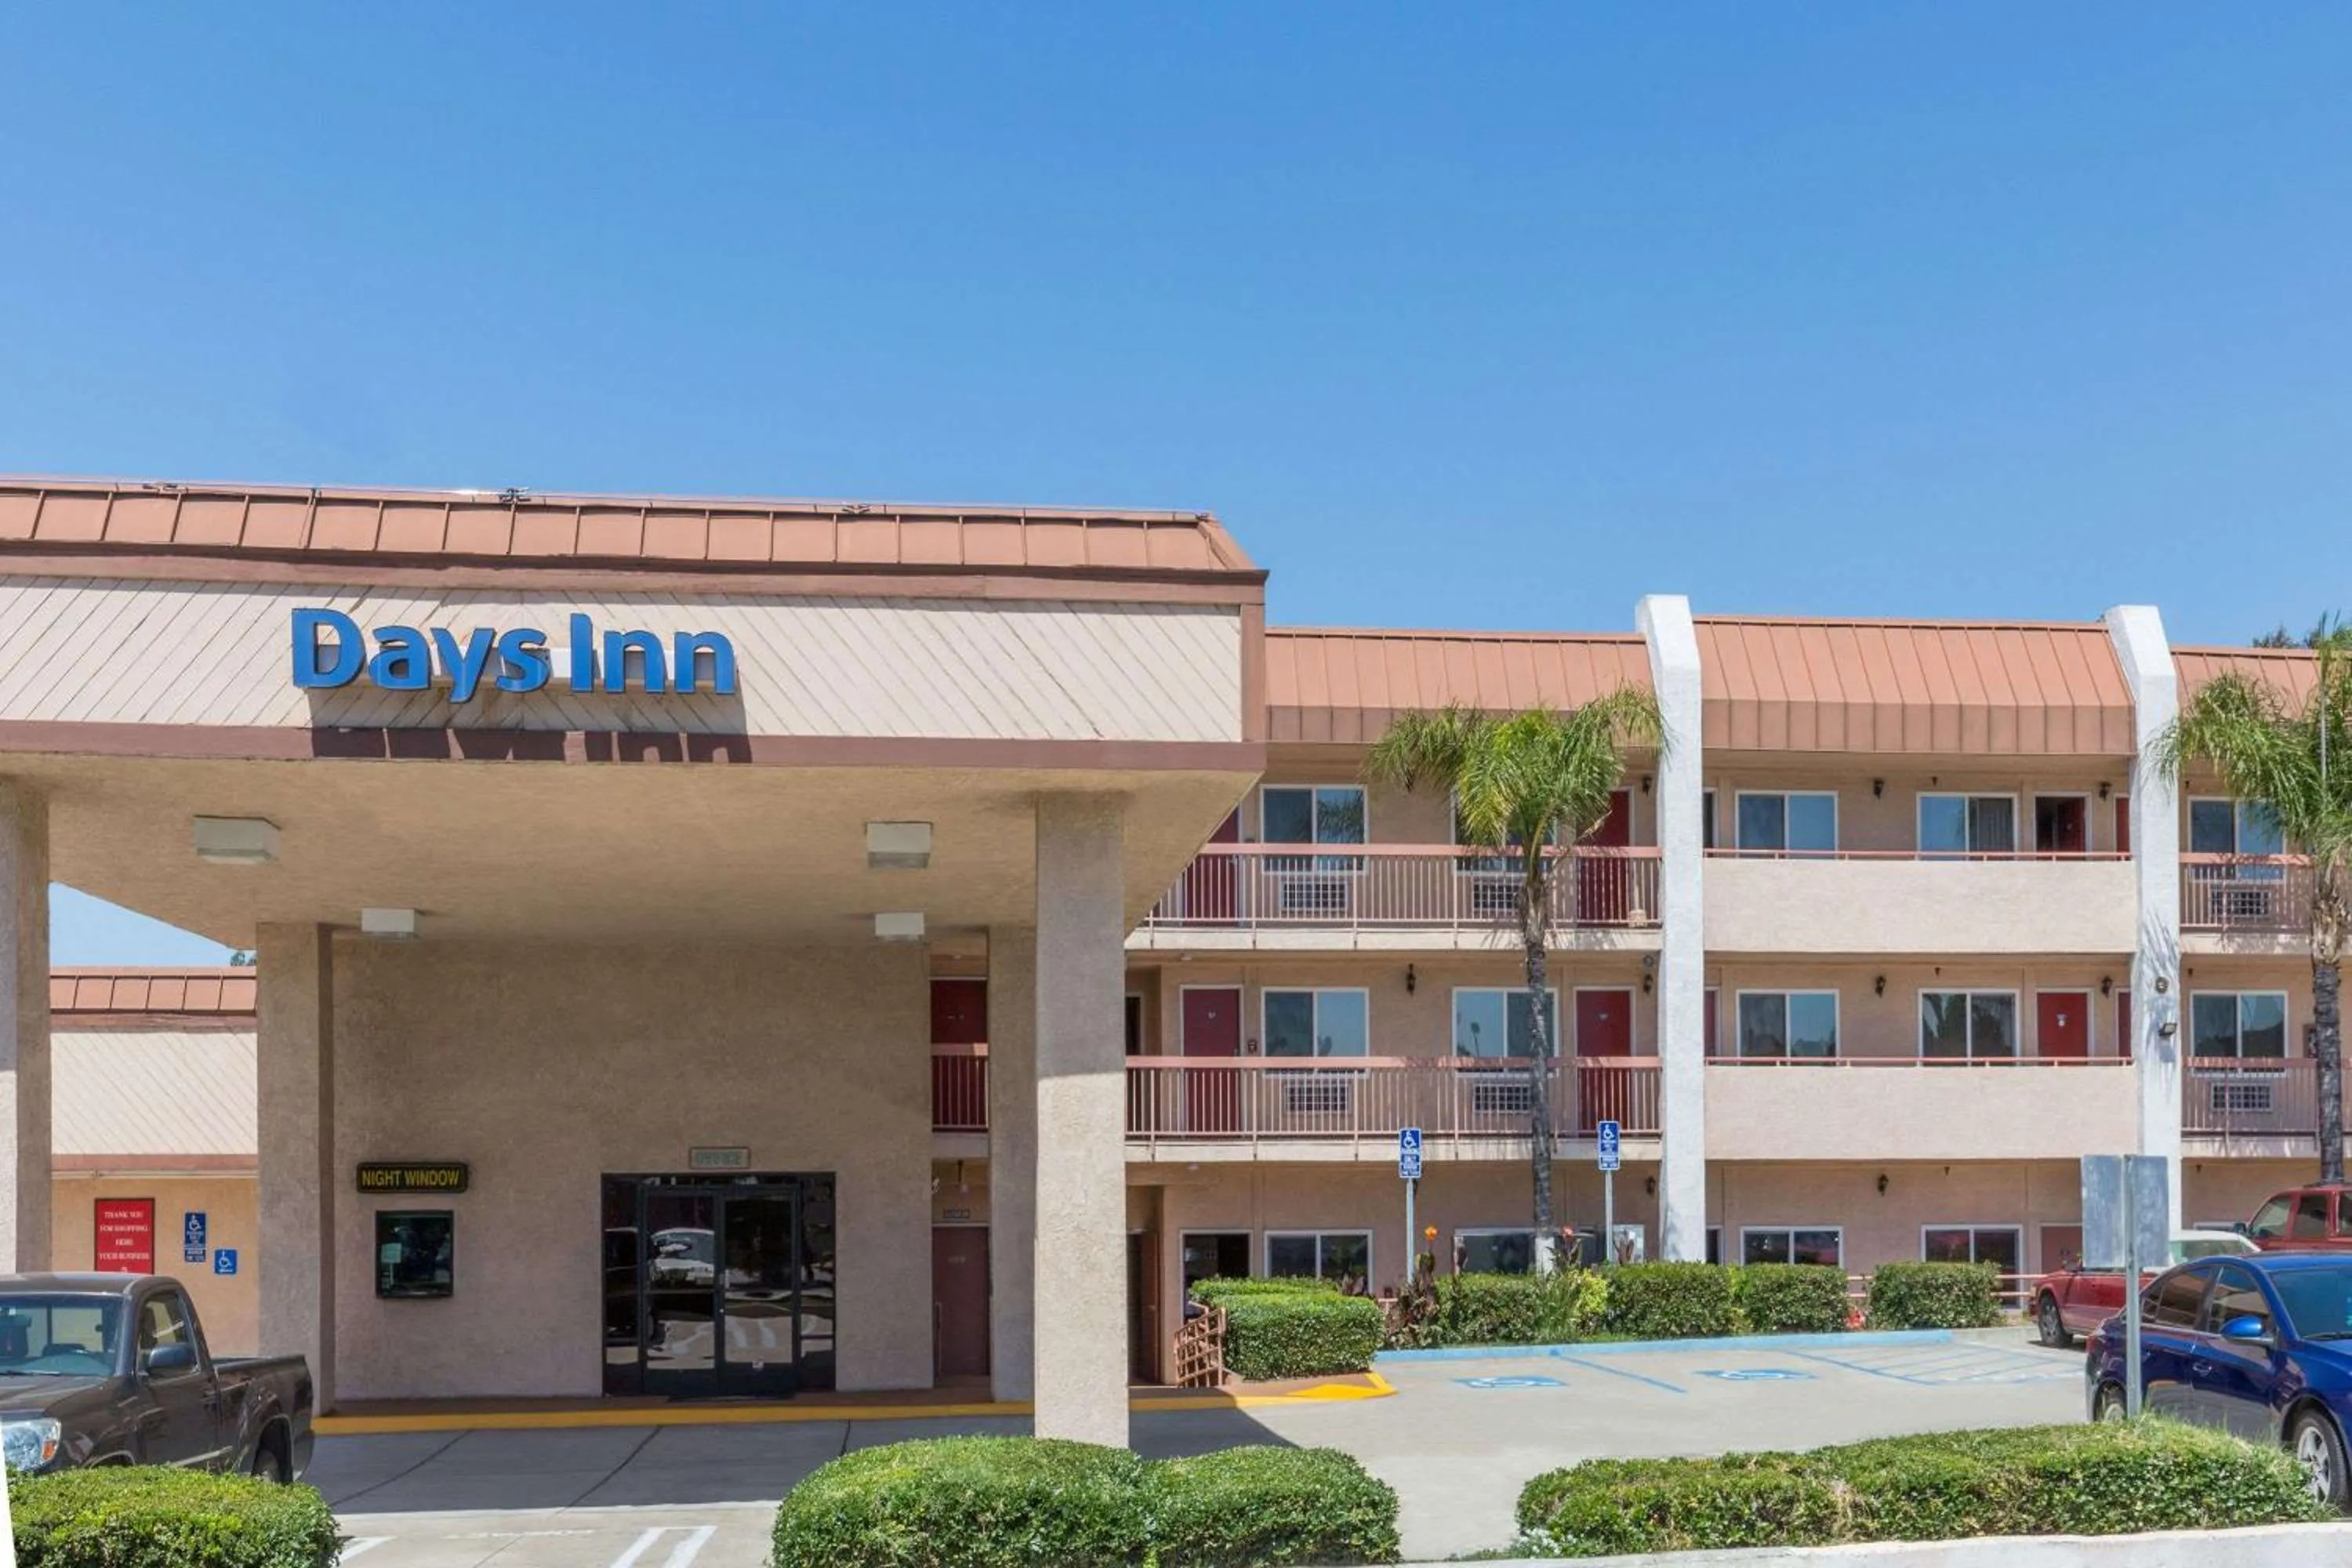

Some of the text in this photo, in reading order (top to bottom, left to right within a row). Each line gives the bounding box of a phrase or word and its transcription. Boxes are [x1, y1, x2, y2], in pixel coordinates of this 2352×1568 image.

[292, 608, 736, 704] Days Inn
[361, 1169, 459, 1186] NIGHT WINDOW
